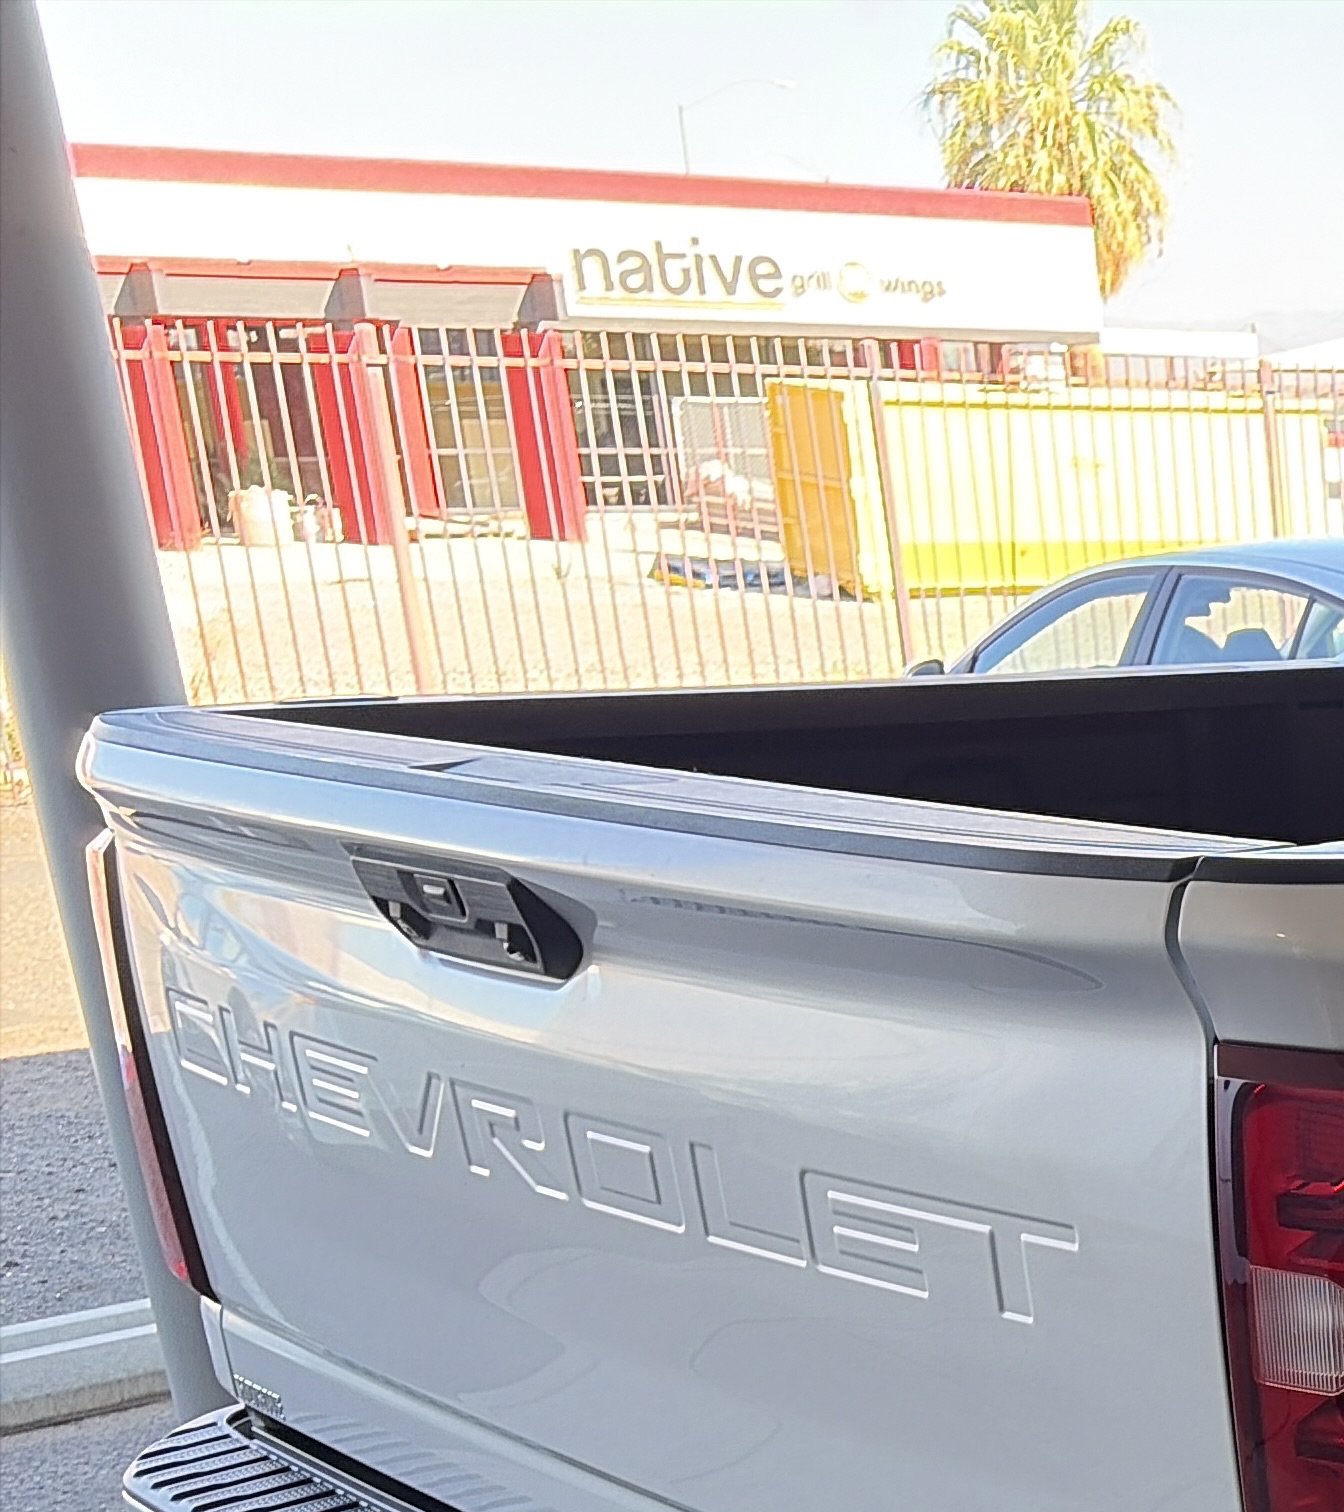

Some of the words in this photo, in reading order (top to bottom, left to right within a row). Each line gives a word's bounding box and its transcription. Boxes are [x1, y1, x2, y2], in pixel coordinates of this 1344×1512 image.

[572, 237, 785, 298] native
[791, 271, 831, 297] grill
[879, 277, 946, 303] wings
[166, 986, 1079, 1324] CHEVROLET
